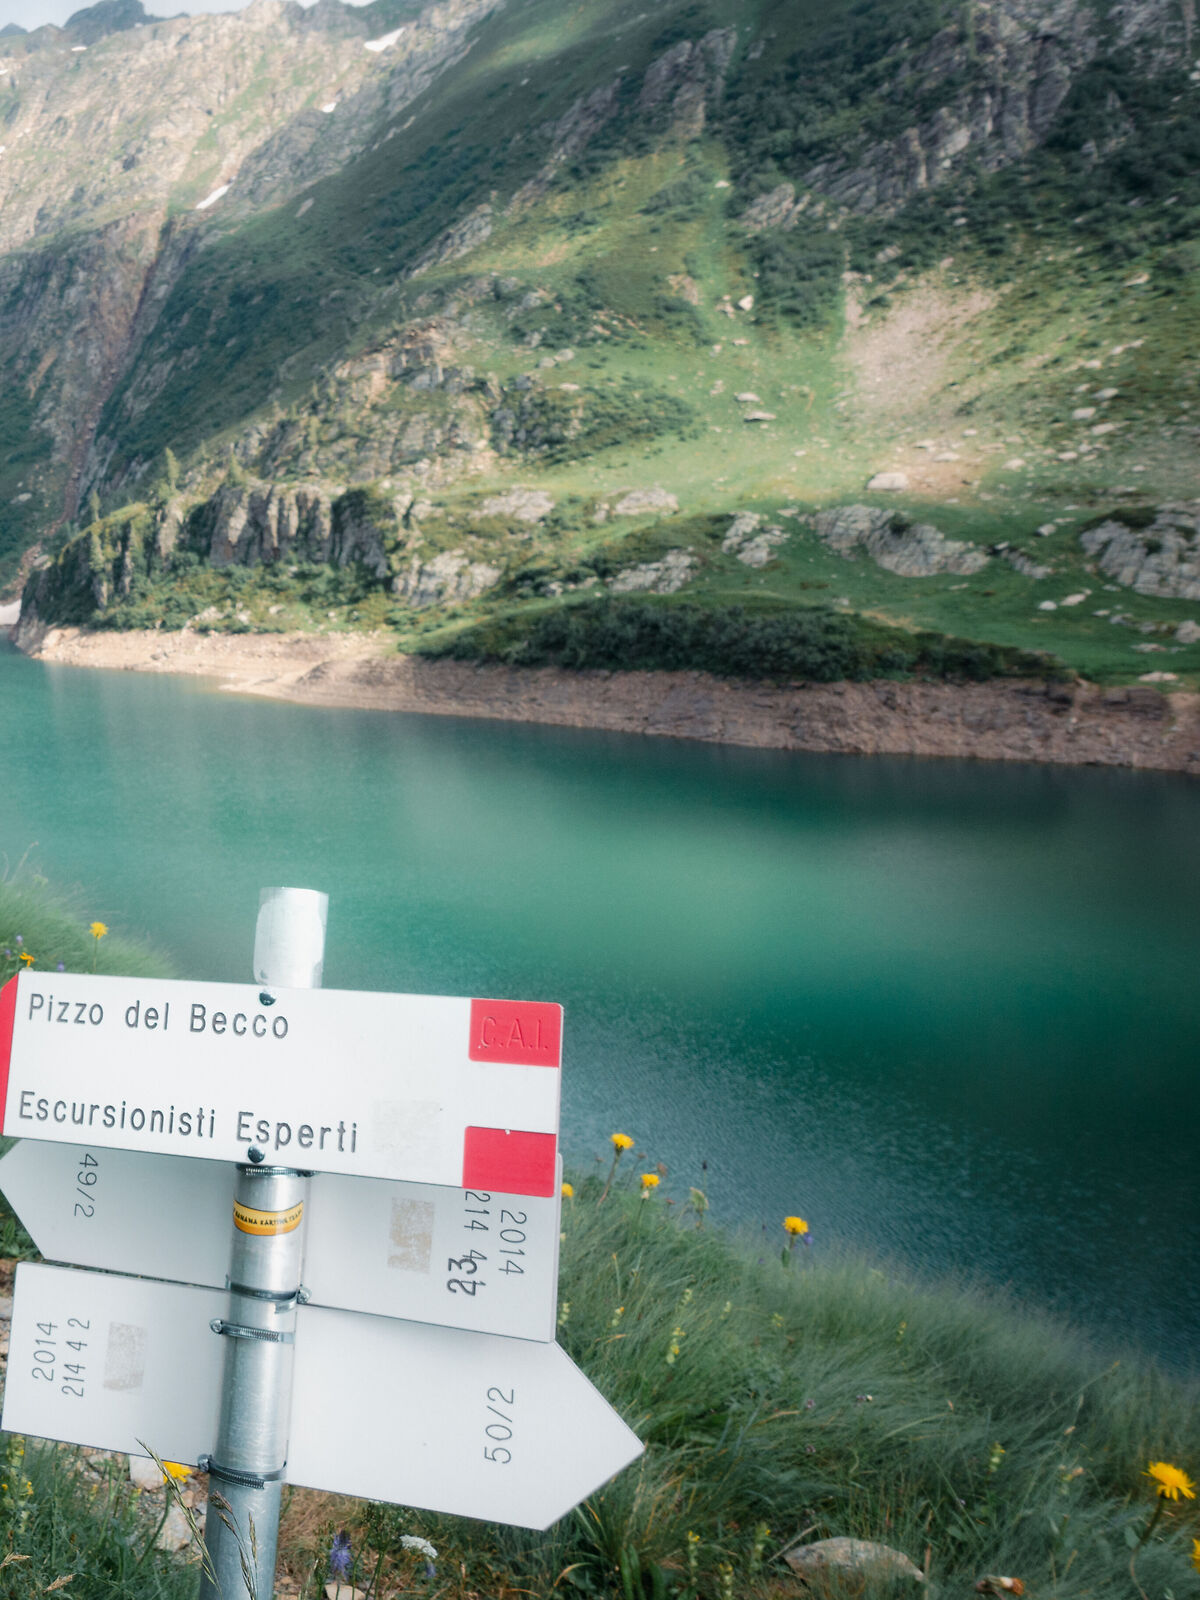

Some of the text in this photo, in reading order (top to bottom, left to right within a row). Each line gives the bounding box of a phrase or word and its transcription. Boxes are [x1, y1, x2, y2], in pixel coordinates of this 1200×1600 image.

[29, 993, 289, 1039] Pizzo del Becco
[481, 1016, 549, 1050] C.A.I.
[19, 1090, 357, 1153] Escursionisti Esperti
[74, 1153, 98, 1217] 49/2
[498, 1210, 527, 1275] 2014
[31, 1322, 58, 1382] 2014
[61, 1364, 86, 1397] 214
[484, 1387, 514, 1464] 50/2
